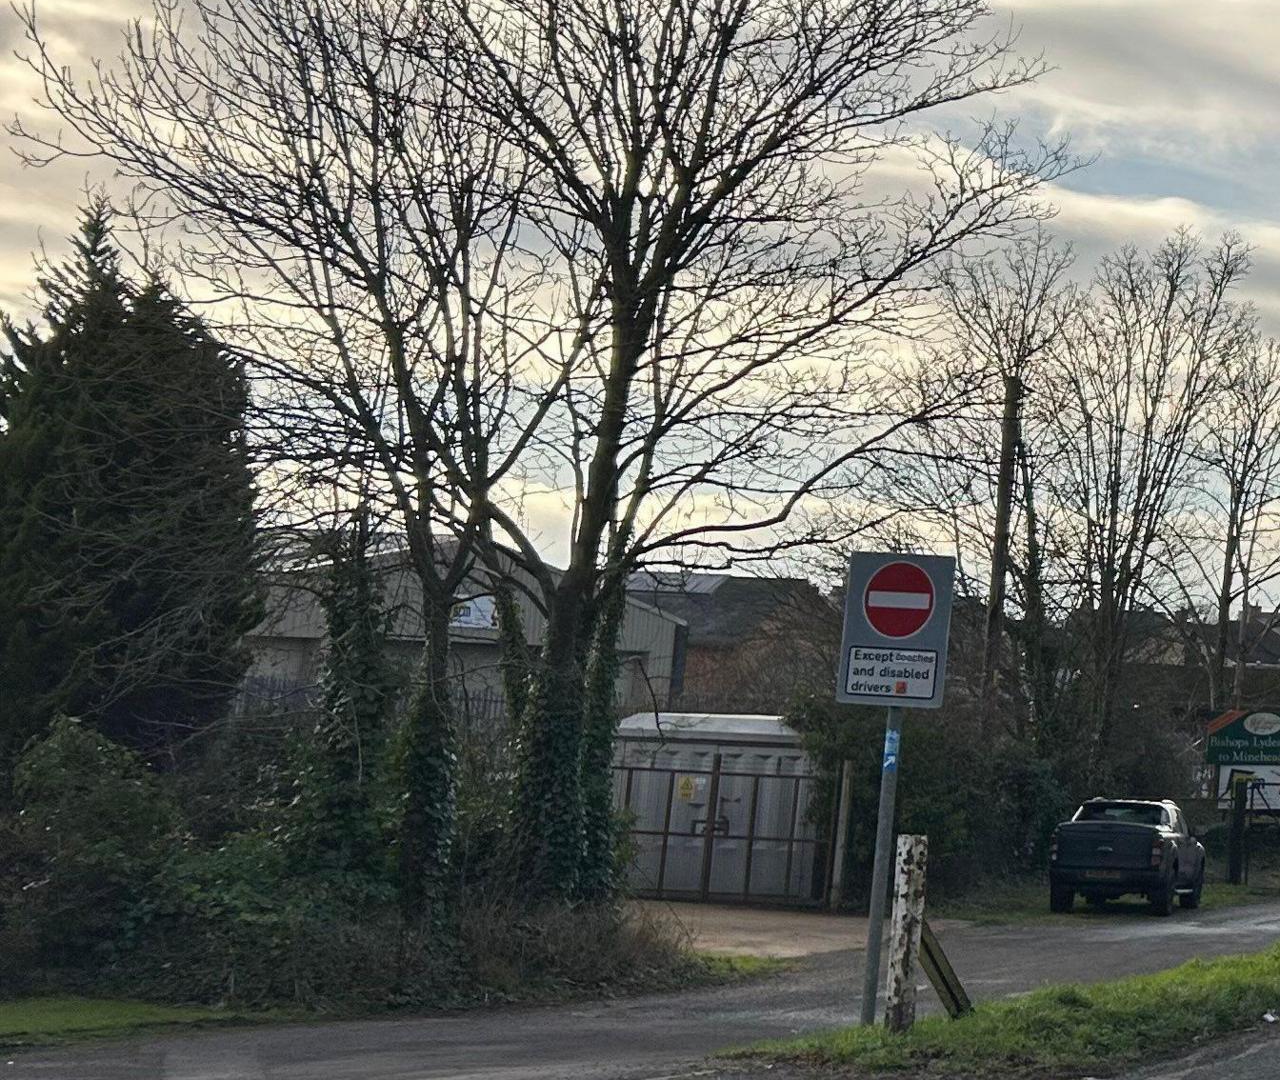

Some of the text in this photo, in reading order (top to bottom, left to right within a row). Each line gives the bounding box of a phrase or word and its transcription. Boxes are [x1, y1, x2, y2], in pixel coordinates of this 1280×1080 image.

[855, 650, 893, 663] Except
[853, 666, 929, 679] and disabled
[851, 681, 891, 692] drivers
[1210, 737, 1249, 748] Bishops
[1219, 752, 1229, 761] to
